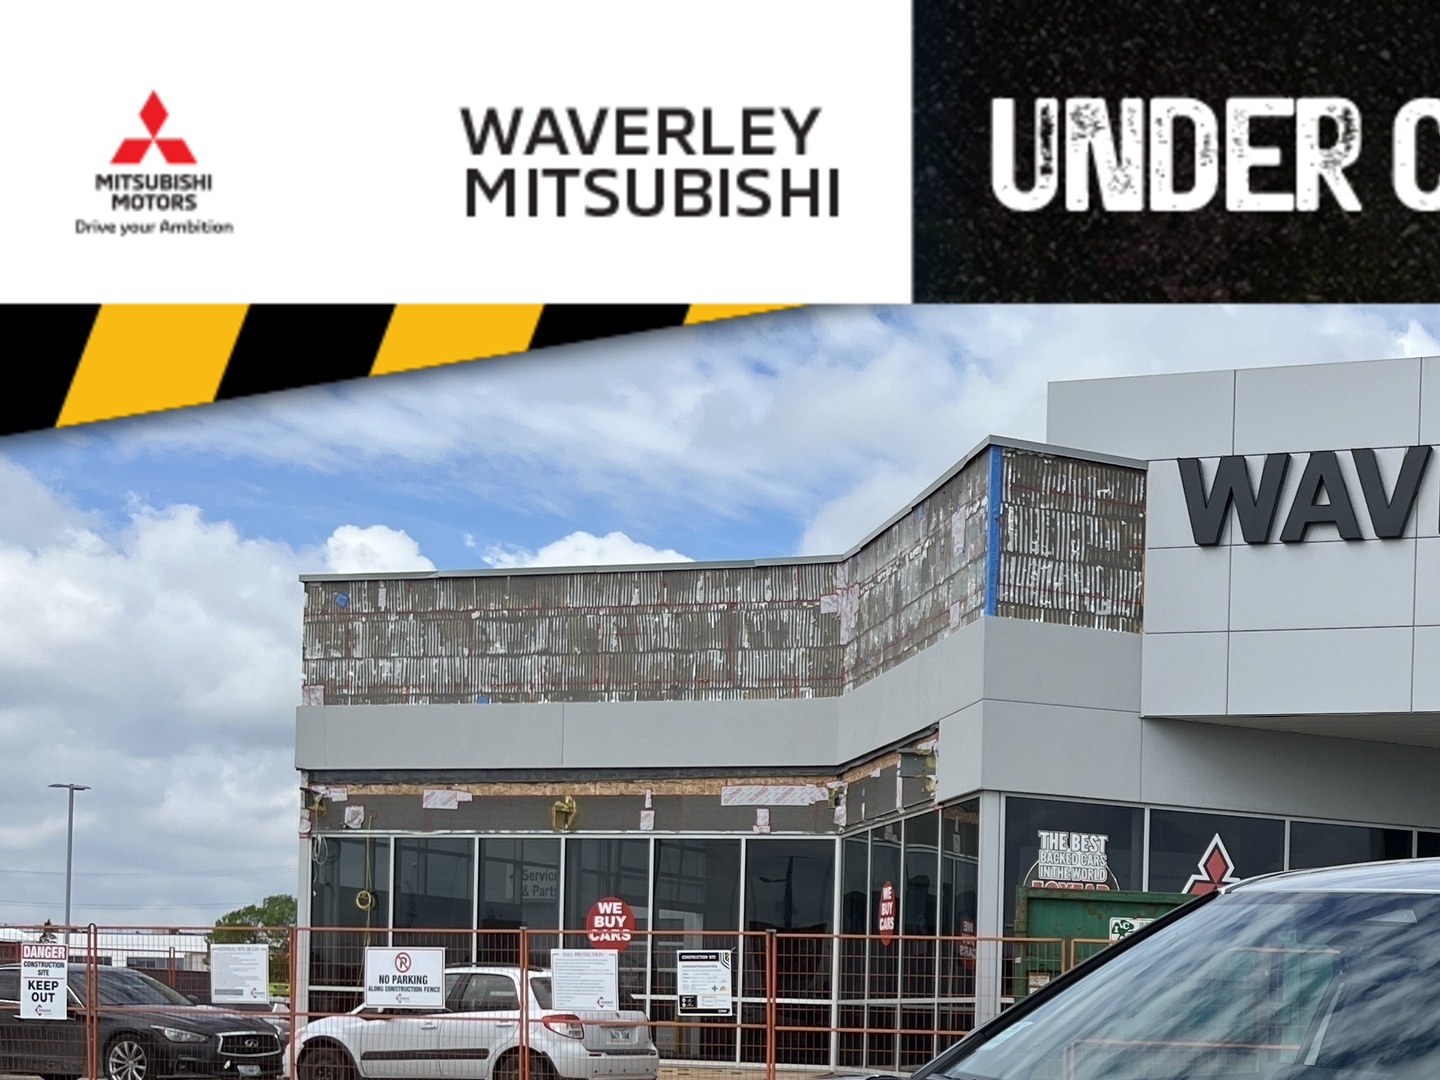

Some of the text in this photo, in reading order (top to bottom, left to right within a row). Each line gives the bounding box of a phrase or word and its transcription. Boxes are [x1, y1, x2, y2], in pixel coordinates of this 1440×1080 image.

[1039, 831, 1108, 854] THE BEST
[1040, 851, 1107, 866] BACKED CARS
[1040, 866, 1107, 881] IN THE WORLD
[533, 885, 559, 897] Parts
[883, 886, 892, 900] WE
[598, 902, 622, 914] WE
[882, 902, 894, 916] BUY
[594, 916, 626, 928] BUY
[880, 917, 894, 930] CARS
[589, 929, 632, 942] CARS
[24, 946, 66, 958] DANGER
[28, 980, 59, 990] KEEP
[379, 975, 428, 984] NO PARKING
[32, 992, 55, 1002] OUT
